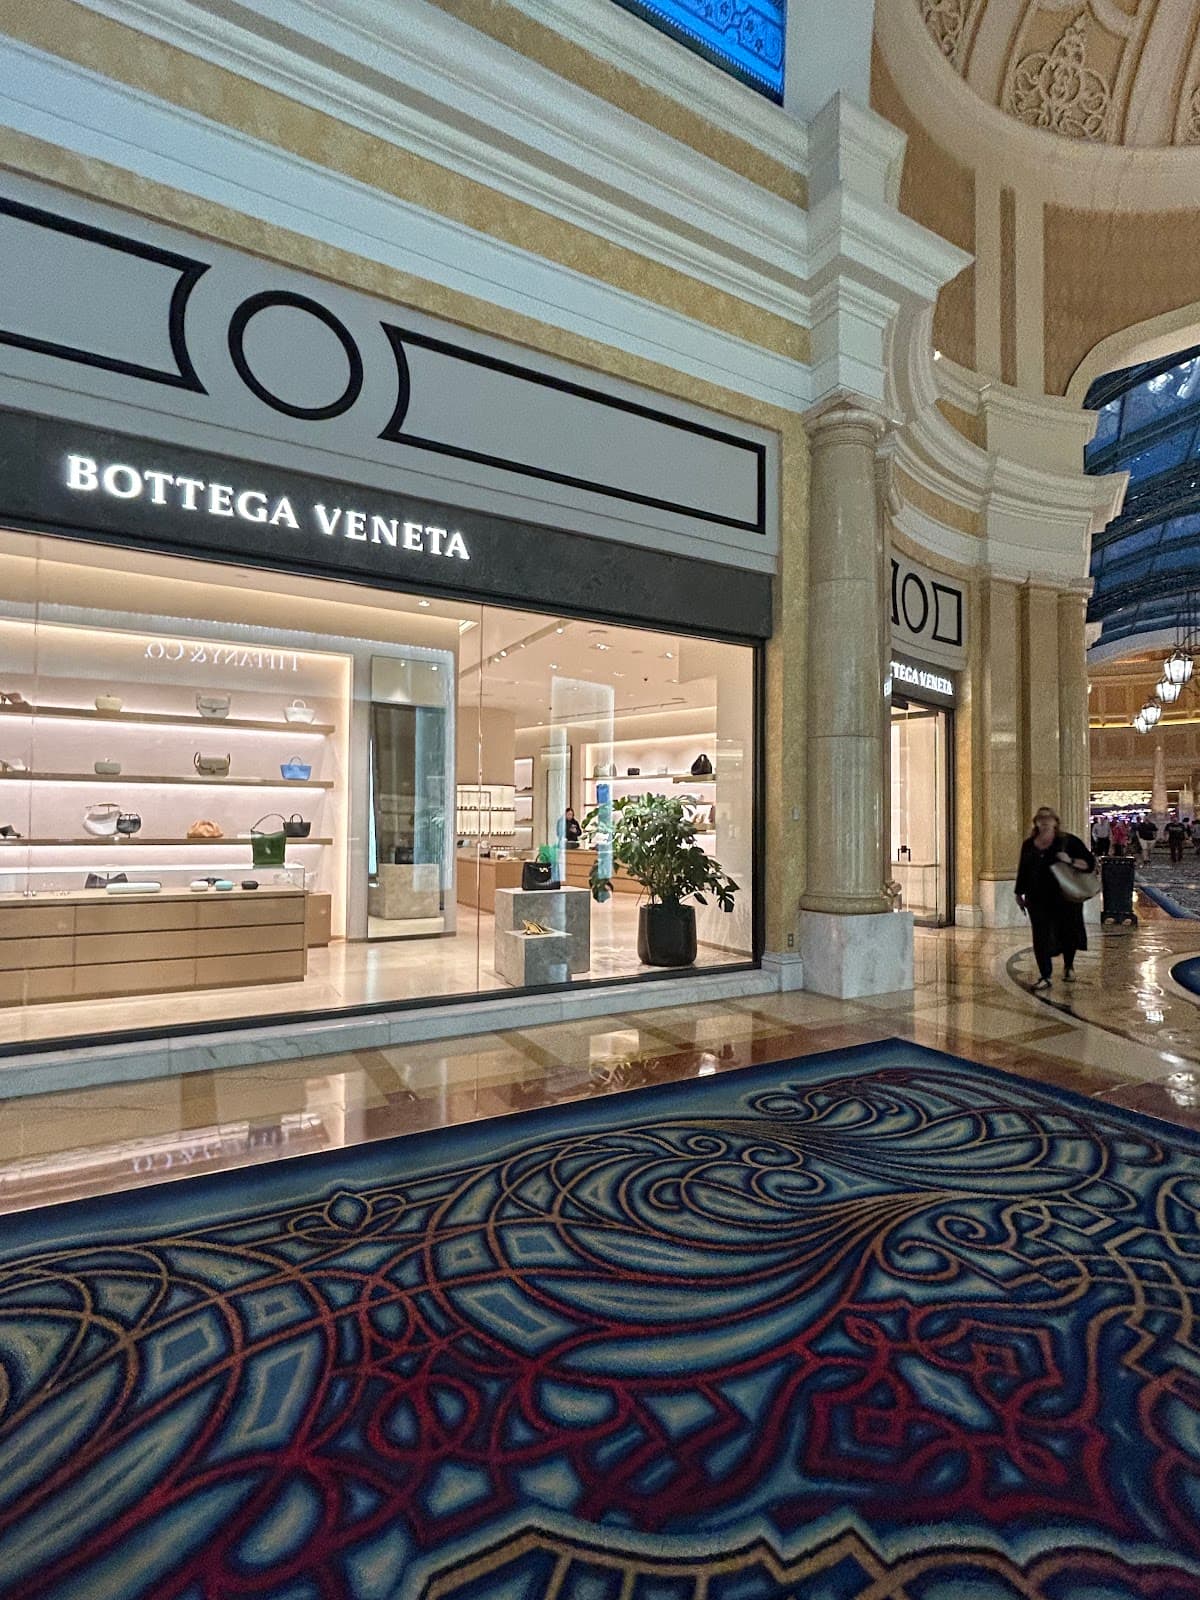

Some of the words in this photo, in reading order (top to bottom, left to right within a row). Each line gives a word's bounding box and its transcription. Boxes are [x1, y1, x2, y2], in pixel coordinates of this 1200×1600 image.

[66, 454, 300, 529] BOTTEGA
[314, 503, 470, 560] VENETA
[919, 671, 954, 696] VENETA
